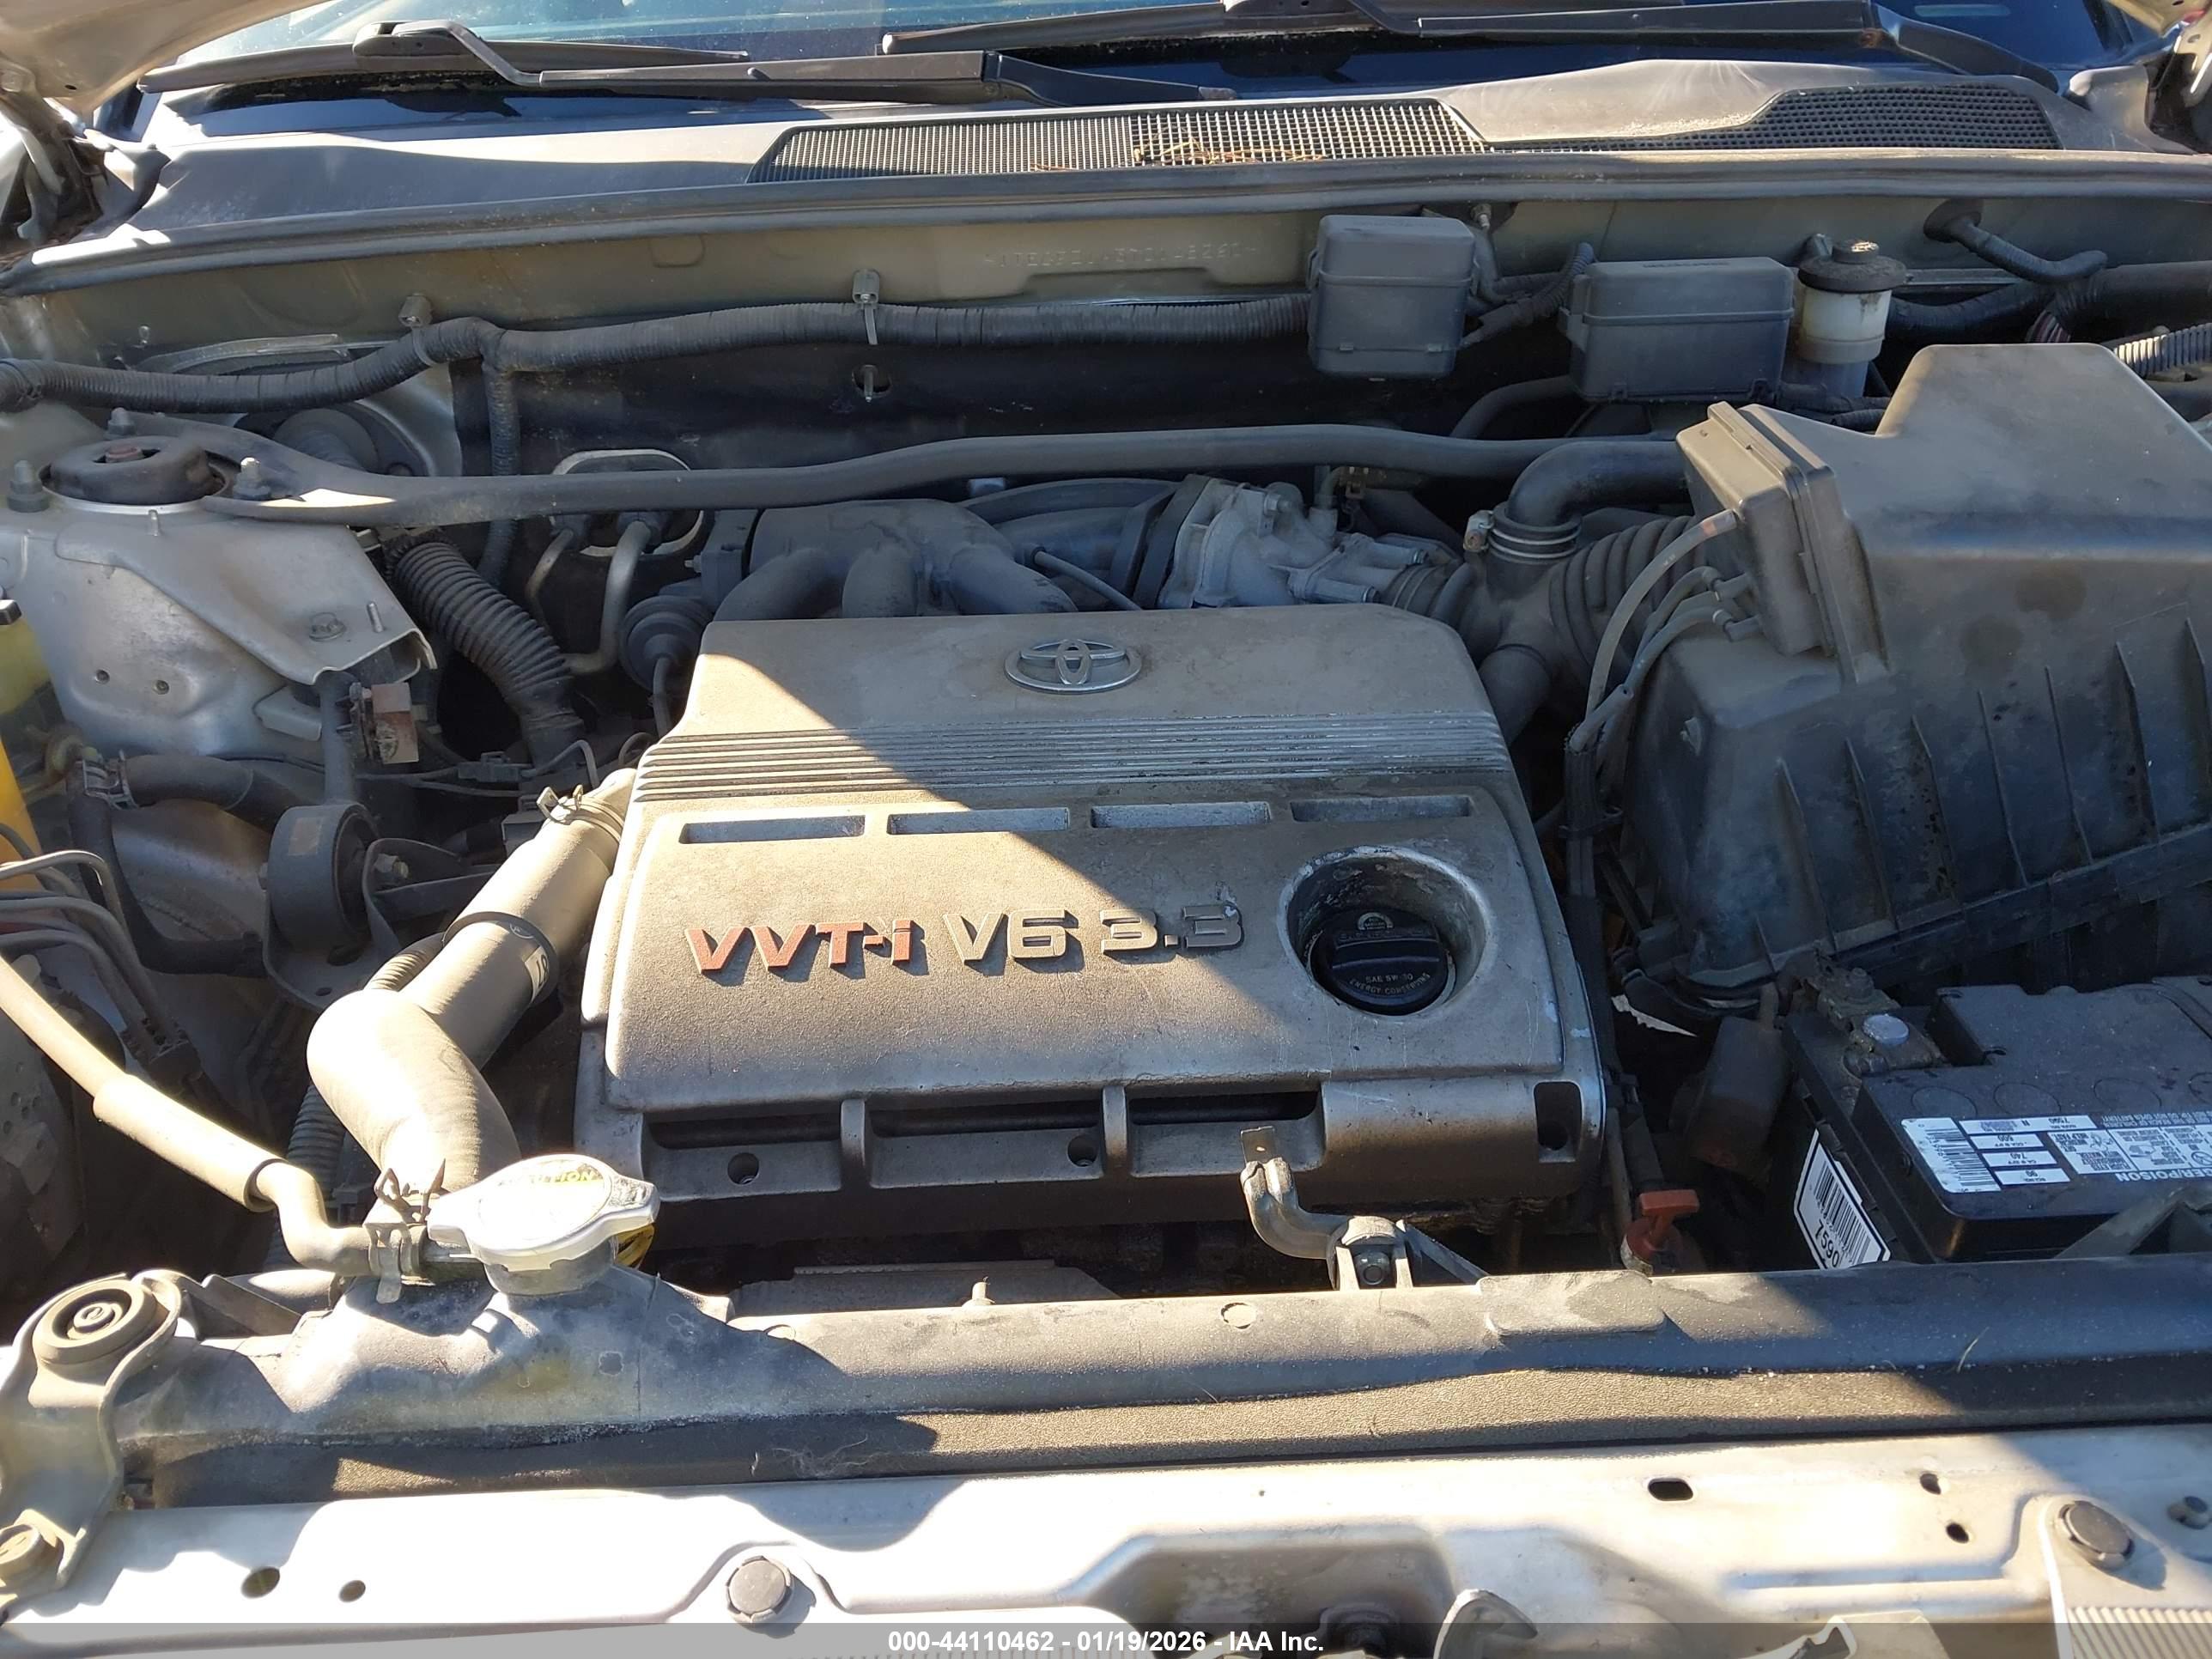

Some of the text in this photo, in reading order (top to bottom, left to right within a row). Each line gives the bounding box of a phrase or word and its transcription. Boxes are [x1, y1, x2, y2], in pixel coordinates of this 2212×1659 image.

[685, 904, 1243, 971] VVT-i V6 3.3
[1814, 1218, 1840, 1267] 7590
